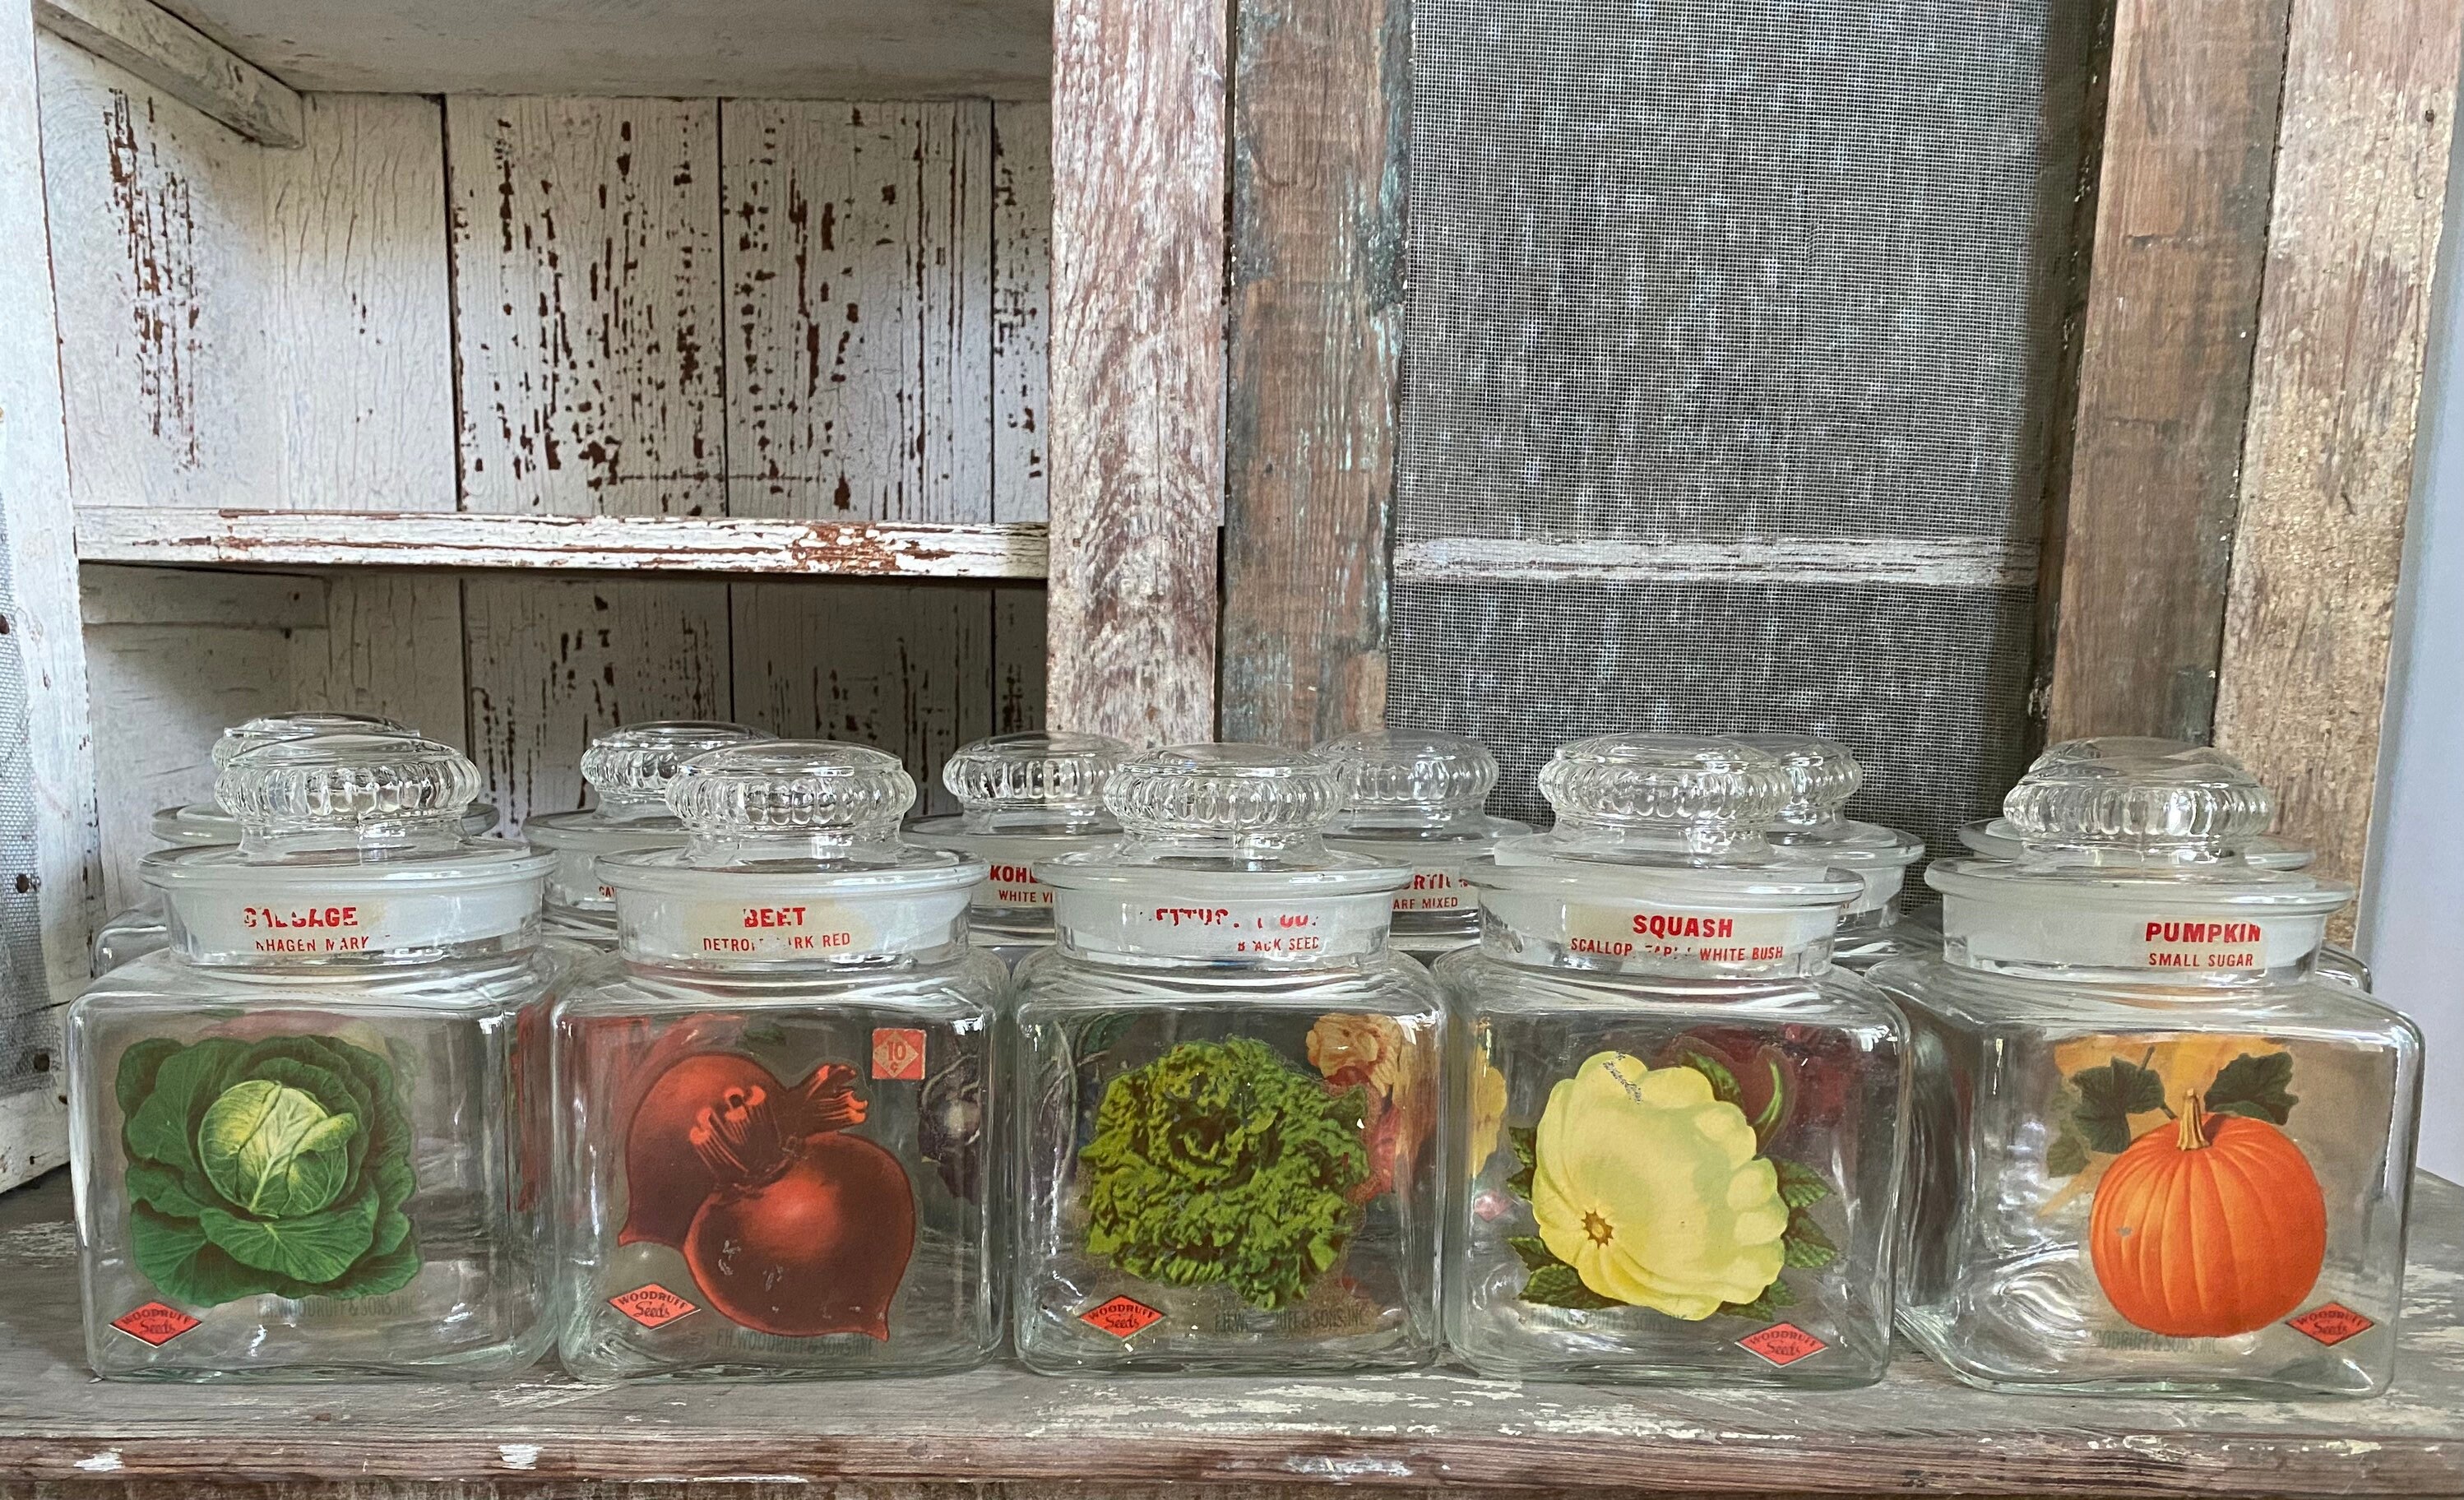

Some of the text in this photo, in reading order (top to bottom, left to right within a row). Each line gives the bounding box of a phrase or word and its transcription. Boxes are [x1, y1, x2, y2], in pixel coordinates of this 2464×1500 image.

[998, 889, 1036, 903] WHITE
[1422, 897, 1458, 909] MIXED
[743, 907, 806, 928] BEET
[1633, 914, 1733, 939] SQUASH
[822, 933, 850, 947] RED
[2146, 922, 2261, 943] PUMPKIN
[1571, 937, 1633, 956] SCALLOP
[1700, 947, 1745, 961] WHITE
[1752, 946, 1783, 960] BUSH
[2148, 952, 2253, 967] SMALL SUGAR
[887, 1041, 905, 1062] 10
[618, 1290, 688, 1310] WOODRUFF
[632, 1300, 671, 1318] Seeds
[1087, 1303, 1156, 1320] WOODRUFF
[1104, 1313, 1140, 1330] Seeds
